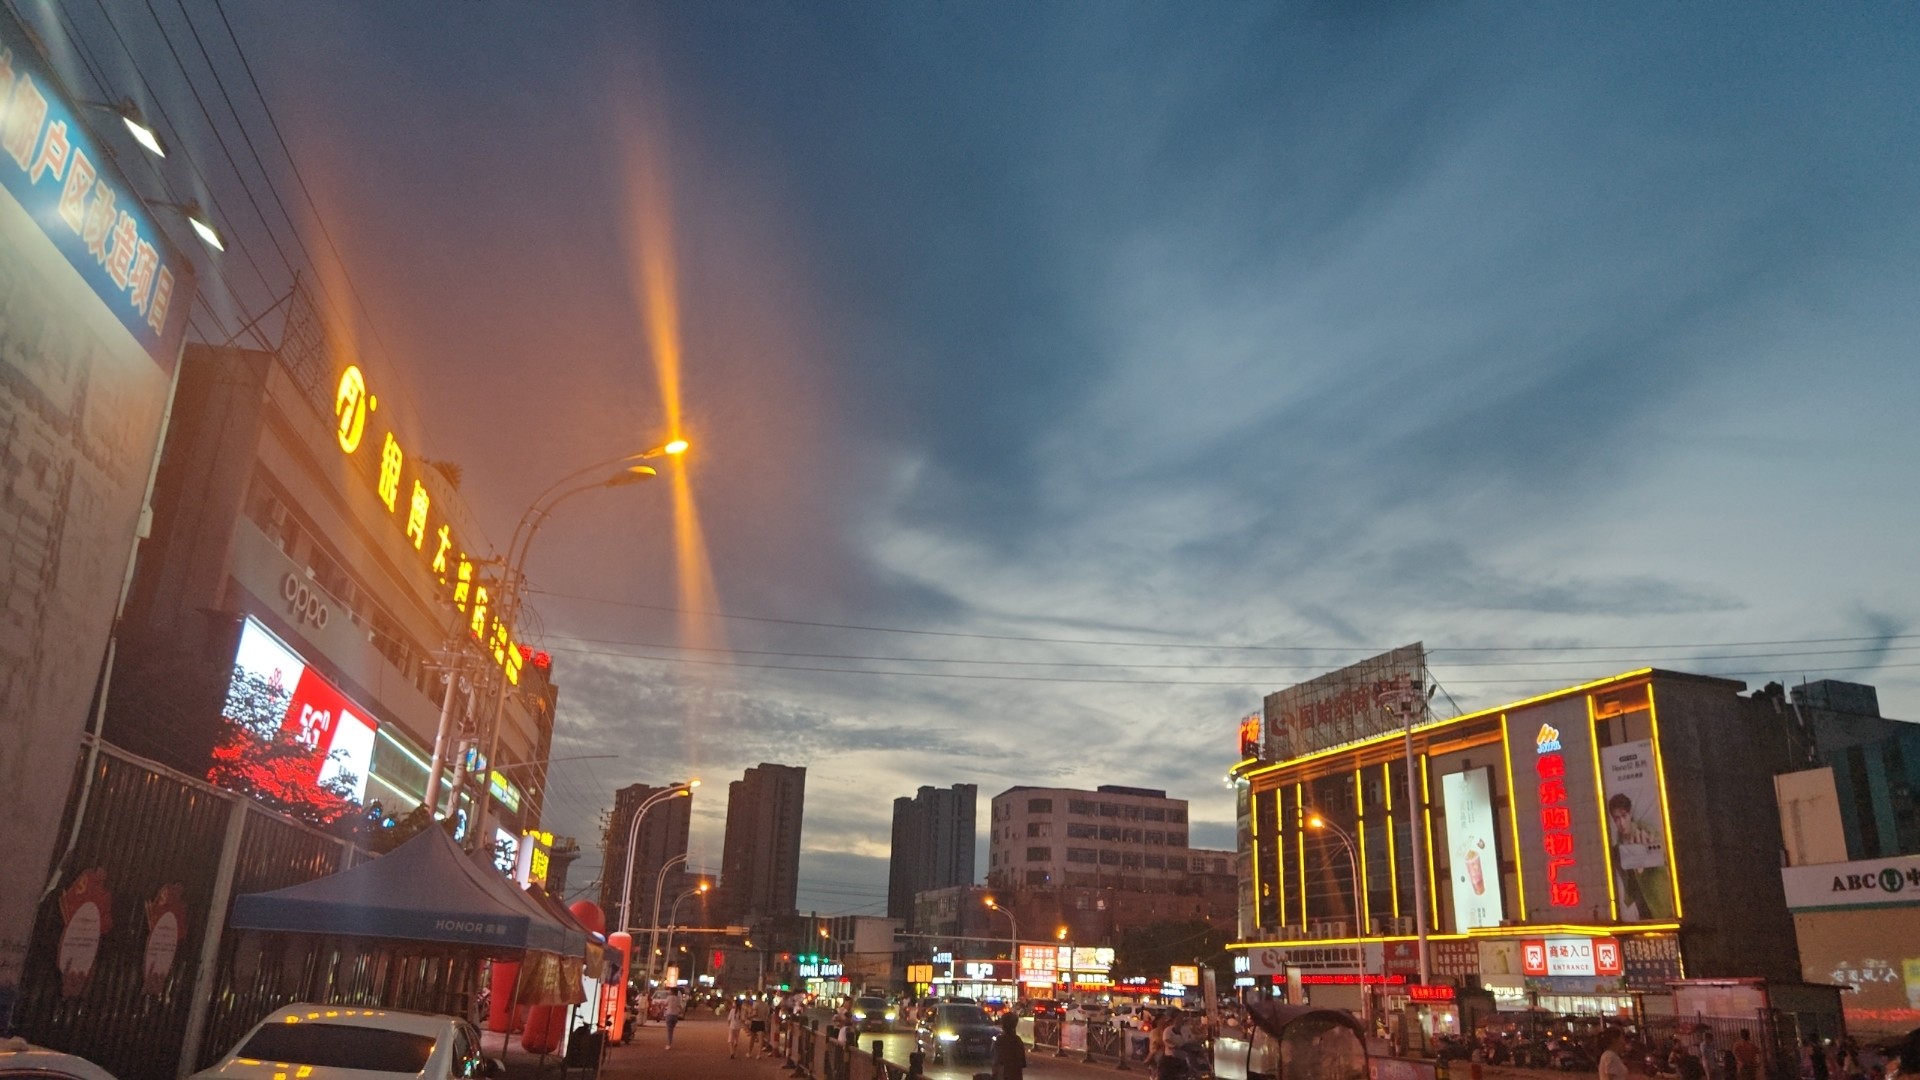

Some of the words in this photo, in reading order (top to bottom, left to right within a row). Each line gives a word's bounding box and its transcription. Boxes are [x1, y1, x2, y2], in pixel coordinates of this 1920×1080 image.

[1536, 754, 1579, 907] 佳乐购物广场
[1832, 872, 1877, 892] ABC
[436, 919, 483, 933] HONOR
[1549, 945, 1590, 957] 商场入口
